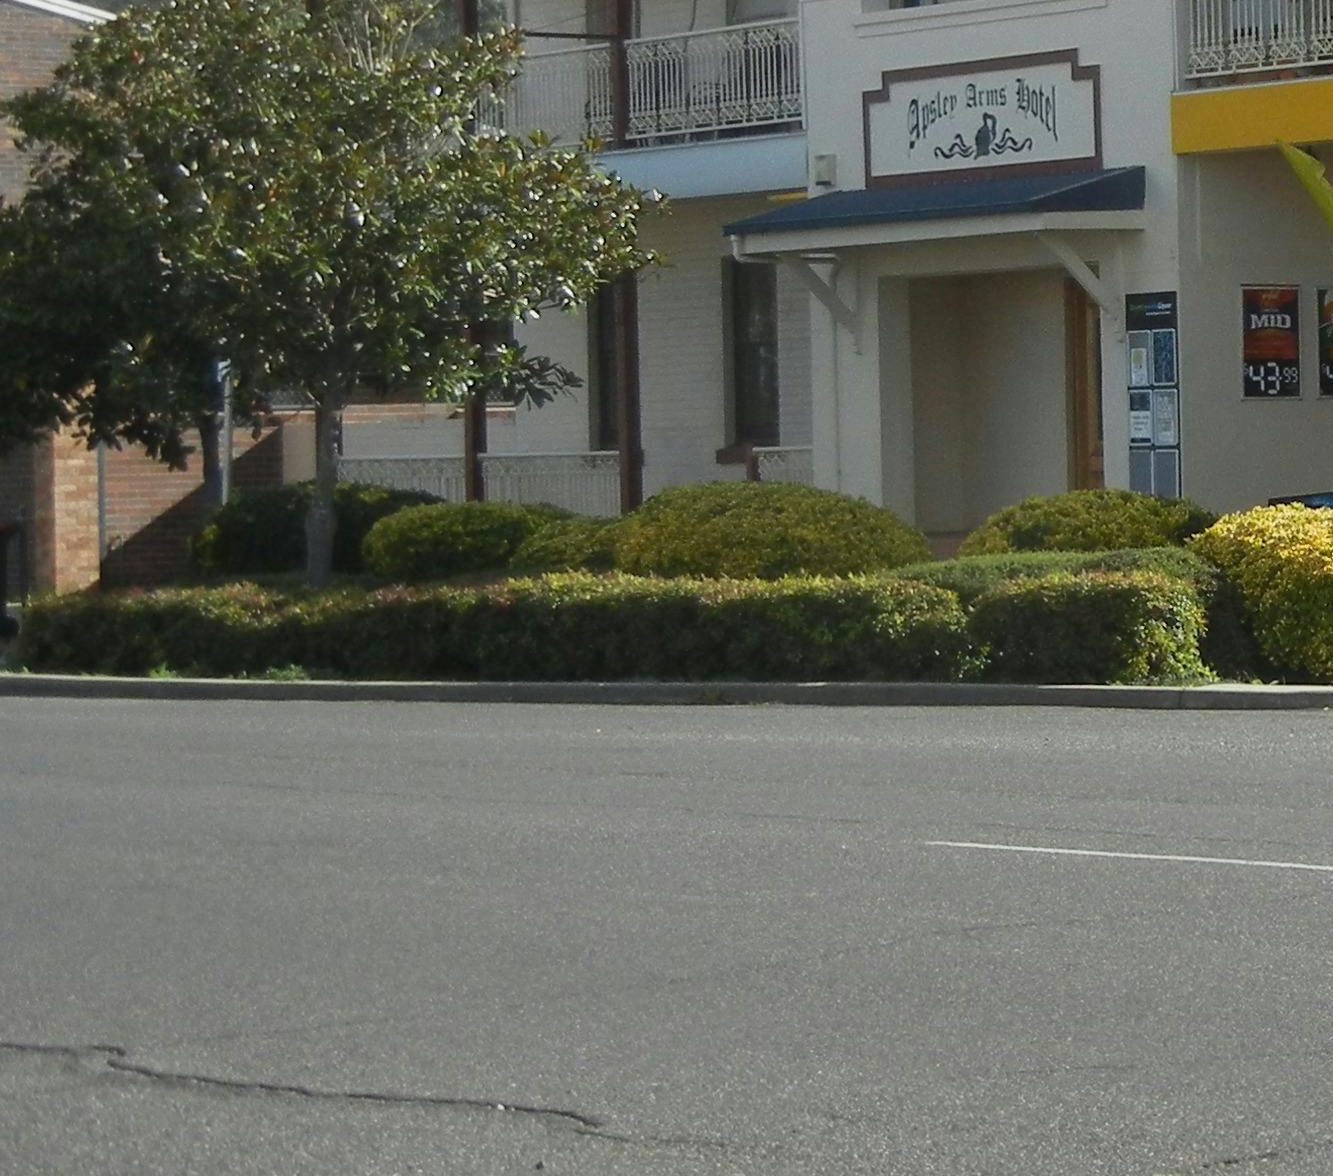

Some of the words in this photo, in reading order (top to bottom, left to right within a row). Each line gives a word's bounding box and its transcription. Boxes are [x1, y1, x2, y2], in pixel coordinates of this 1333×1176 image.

[907, 90, 957, 158] Apsley
[965, 83, 1007, 108] Arms
[1015, 78, 1059, 142] Hotel
[1250, 313, 1291, 329] MID
